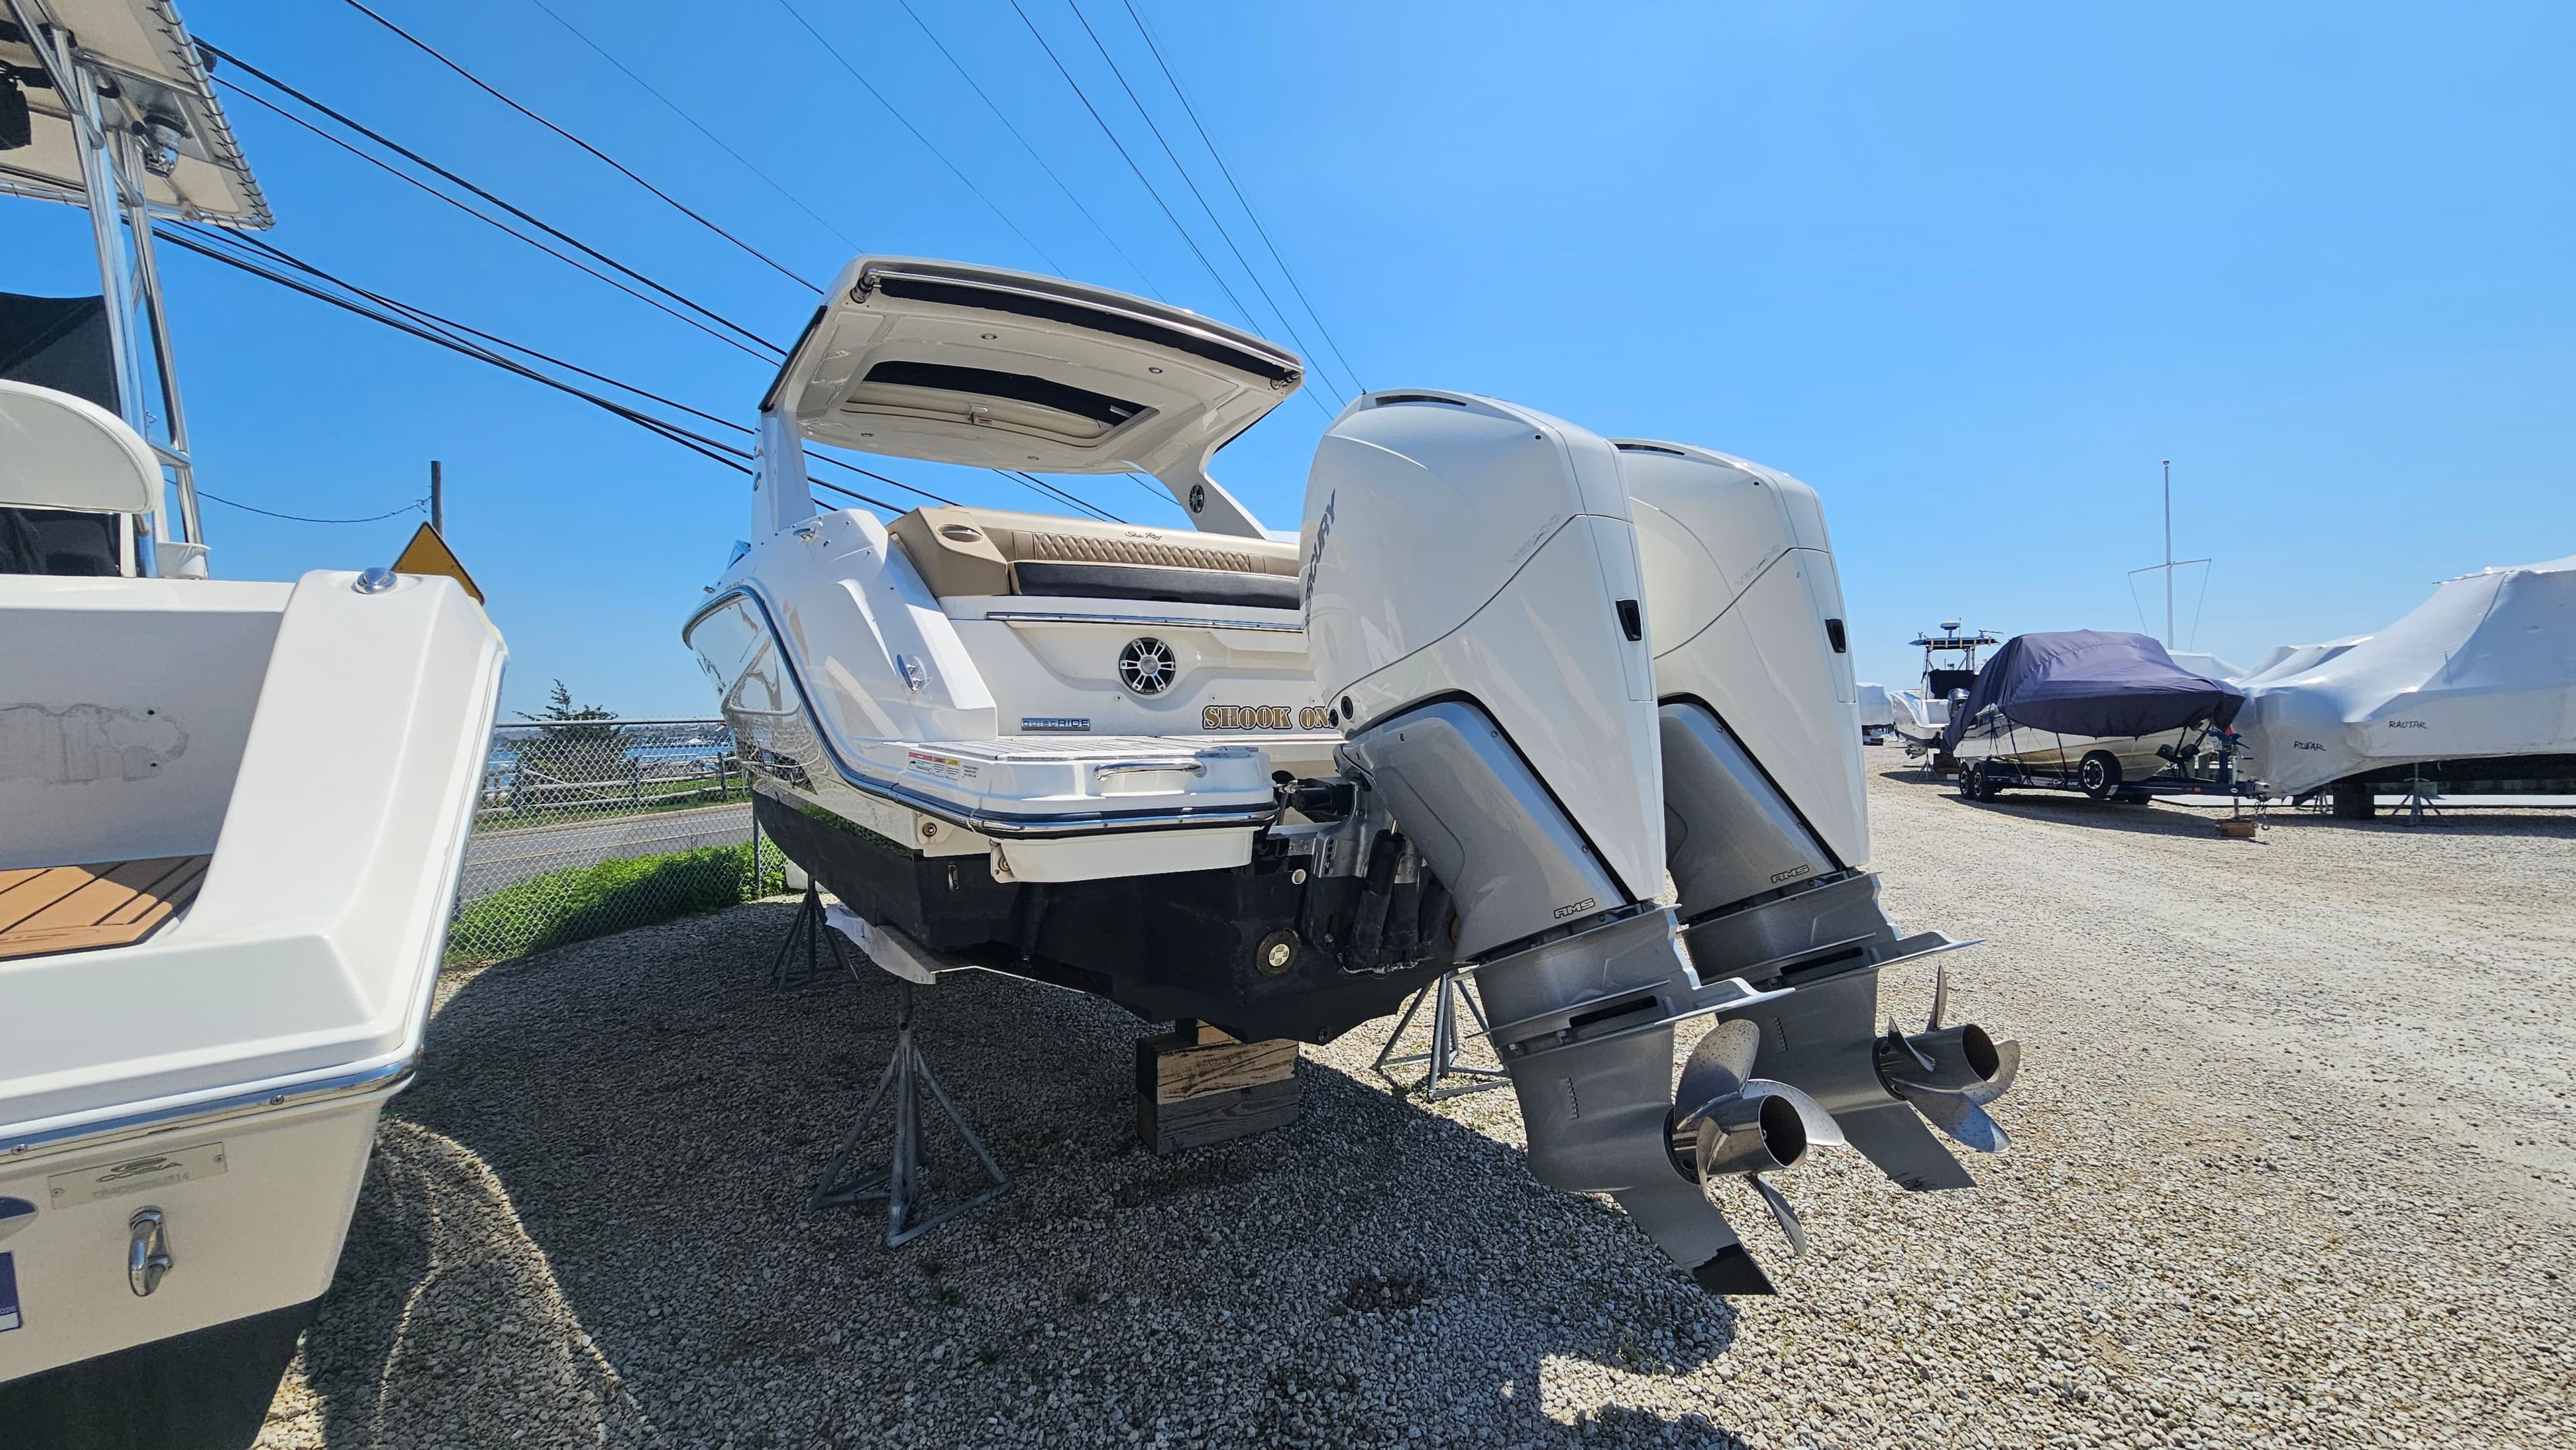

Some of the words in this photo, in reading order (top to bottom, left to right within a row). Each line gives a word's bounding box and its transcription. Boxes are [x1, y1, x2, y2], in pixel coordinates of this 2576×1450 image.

[1202, 706, 1293, 730] SHOOK
[1299, 706, 1335, 730] ON
[1772, 865, 1810, 883] AMS
[1554, 897, 1595, 919] AMS
